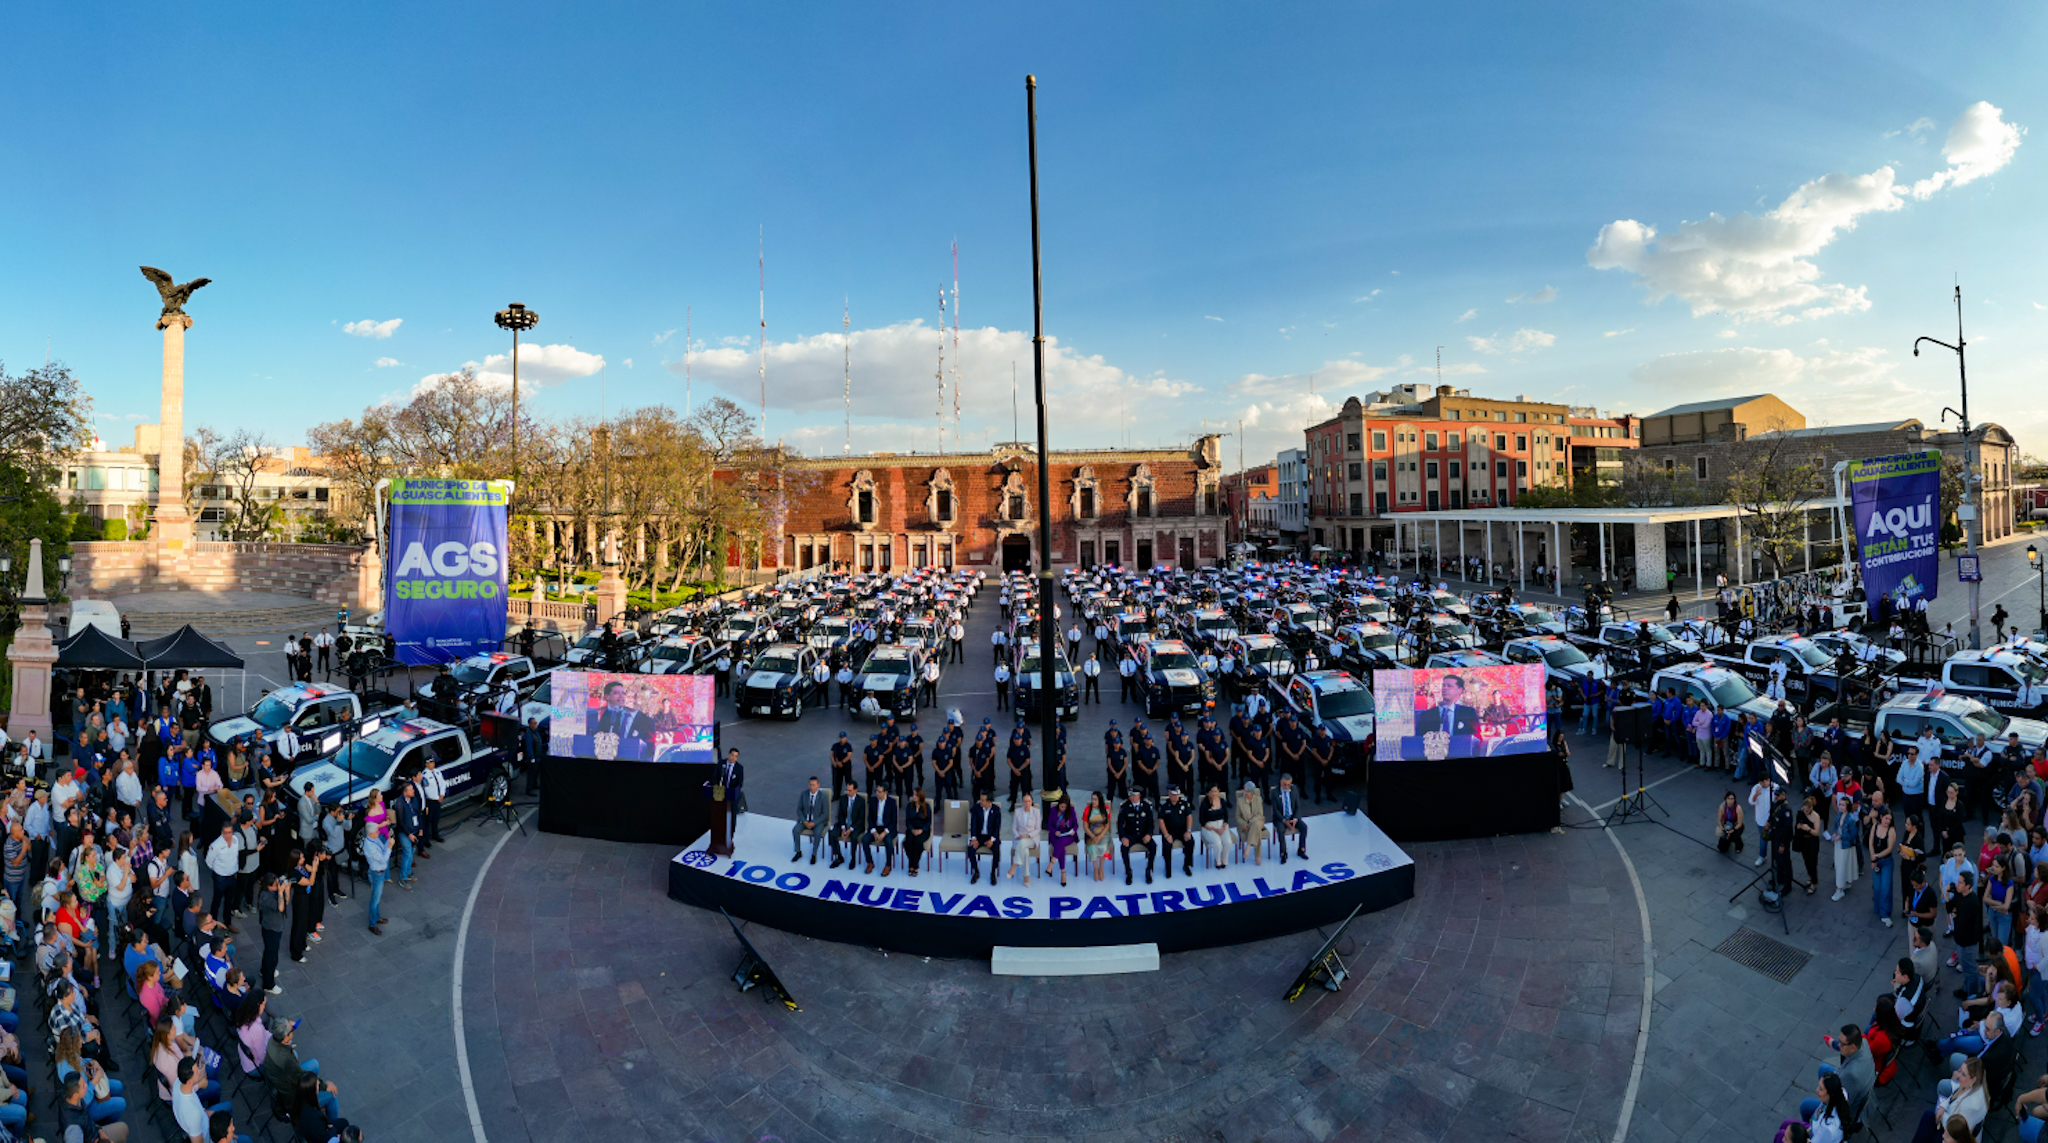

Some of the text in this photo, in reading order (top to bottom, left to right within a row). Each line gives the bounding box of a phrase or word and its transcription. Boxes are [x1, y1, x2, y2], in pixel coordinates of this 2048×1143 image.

[1862, 451, 1927, 467] MUNICIPIO DE
[1853, 460, 1936, 478] AGUASCALIENTES
[405, 480, 488, 490] MUNICIPIO DE
[392, 490, 502, 501] AGUASCALIENTES
[1866, 494, 1932, 538] AQUÍ
[1864, 535, 1908, 558] ESTÁN
[395, 541, 499, 577] AGS
[395, 580, 499, 599] SEGURO
[724, 860, 1355, 919] 100 NUEVAS PATRULLAS
